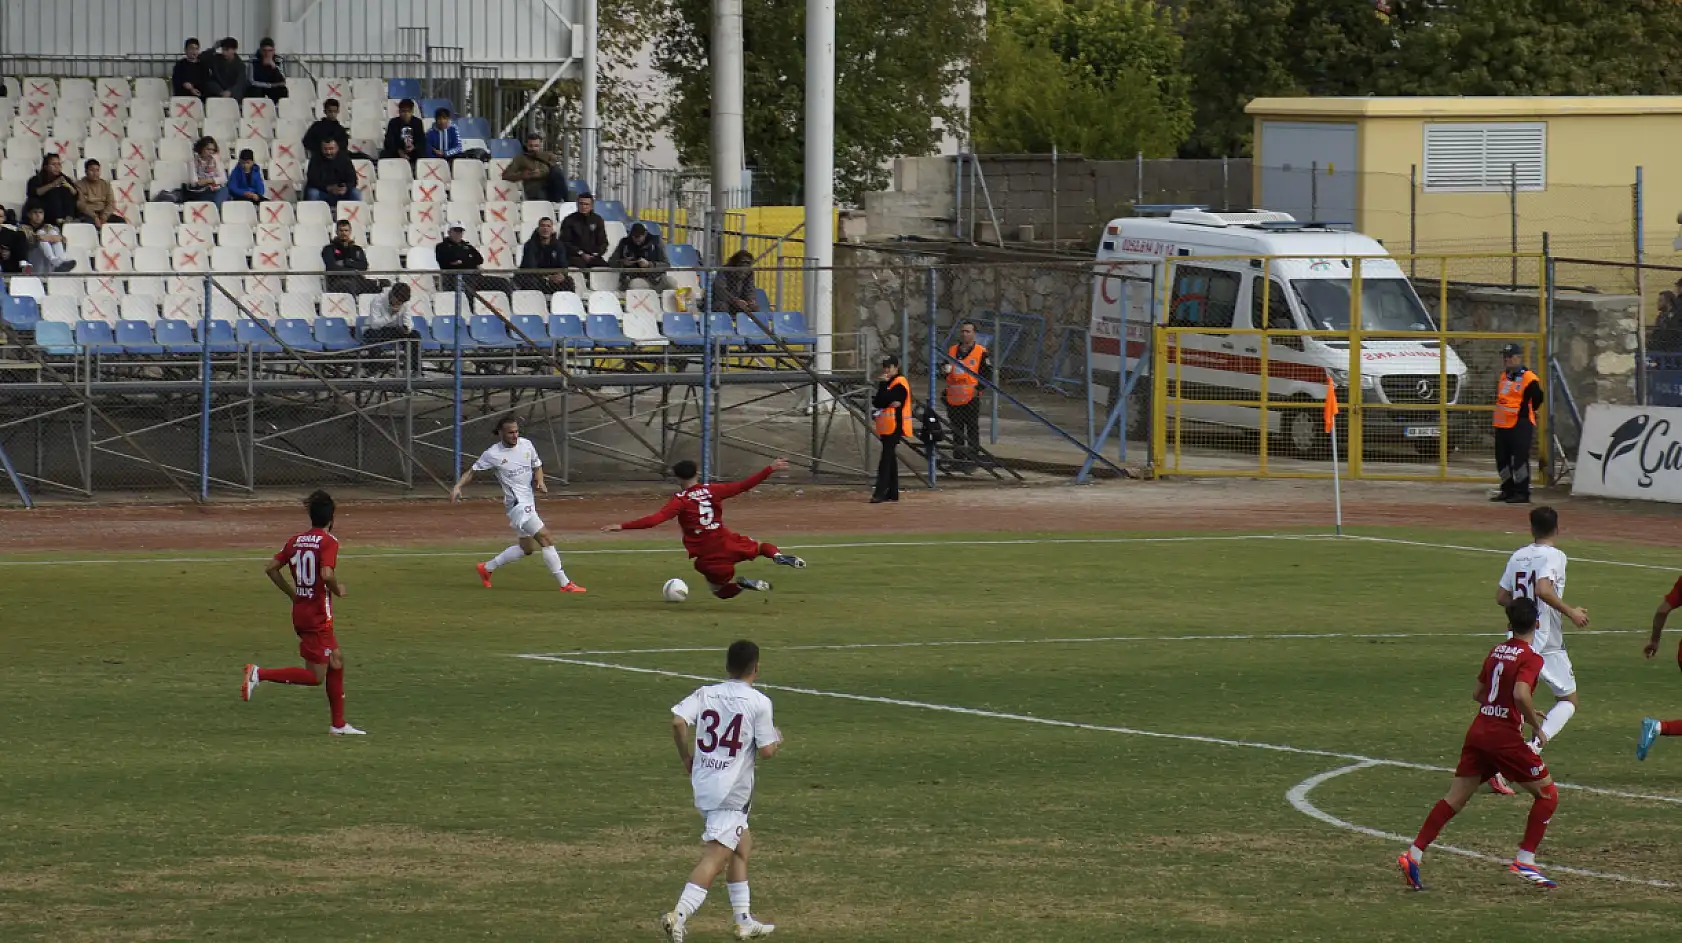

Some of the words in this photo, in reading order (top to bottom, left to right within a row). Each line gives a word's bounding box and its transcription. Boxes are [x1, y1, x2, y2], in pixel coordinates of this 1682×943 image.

[698, 500, 715, 526] 5
[290, 549, 316, 586] 10
[1515, 570, 1537, 600] 51
[697, 708, 744, 757] 34
[700, 756, 730, 771] YUSUF
